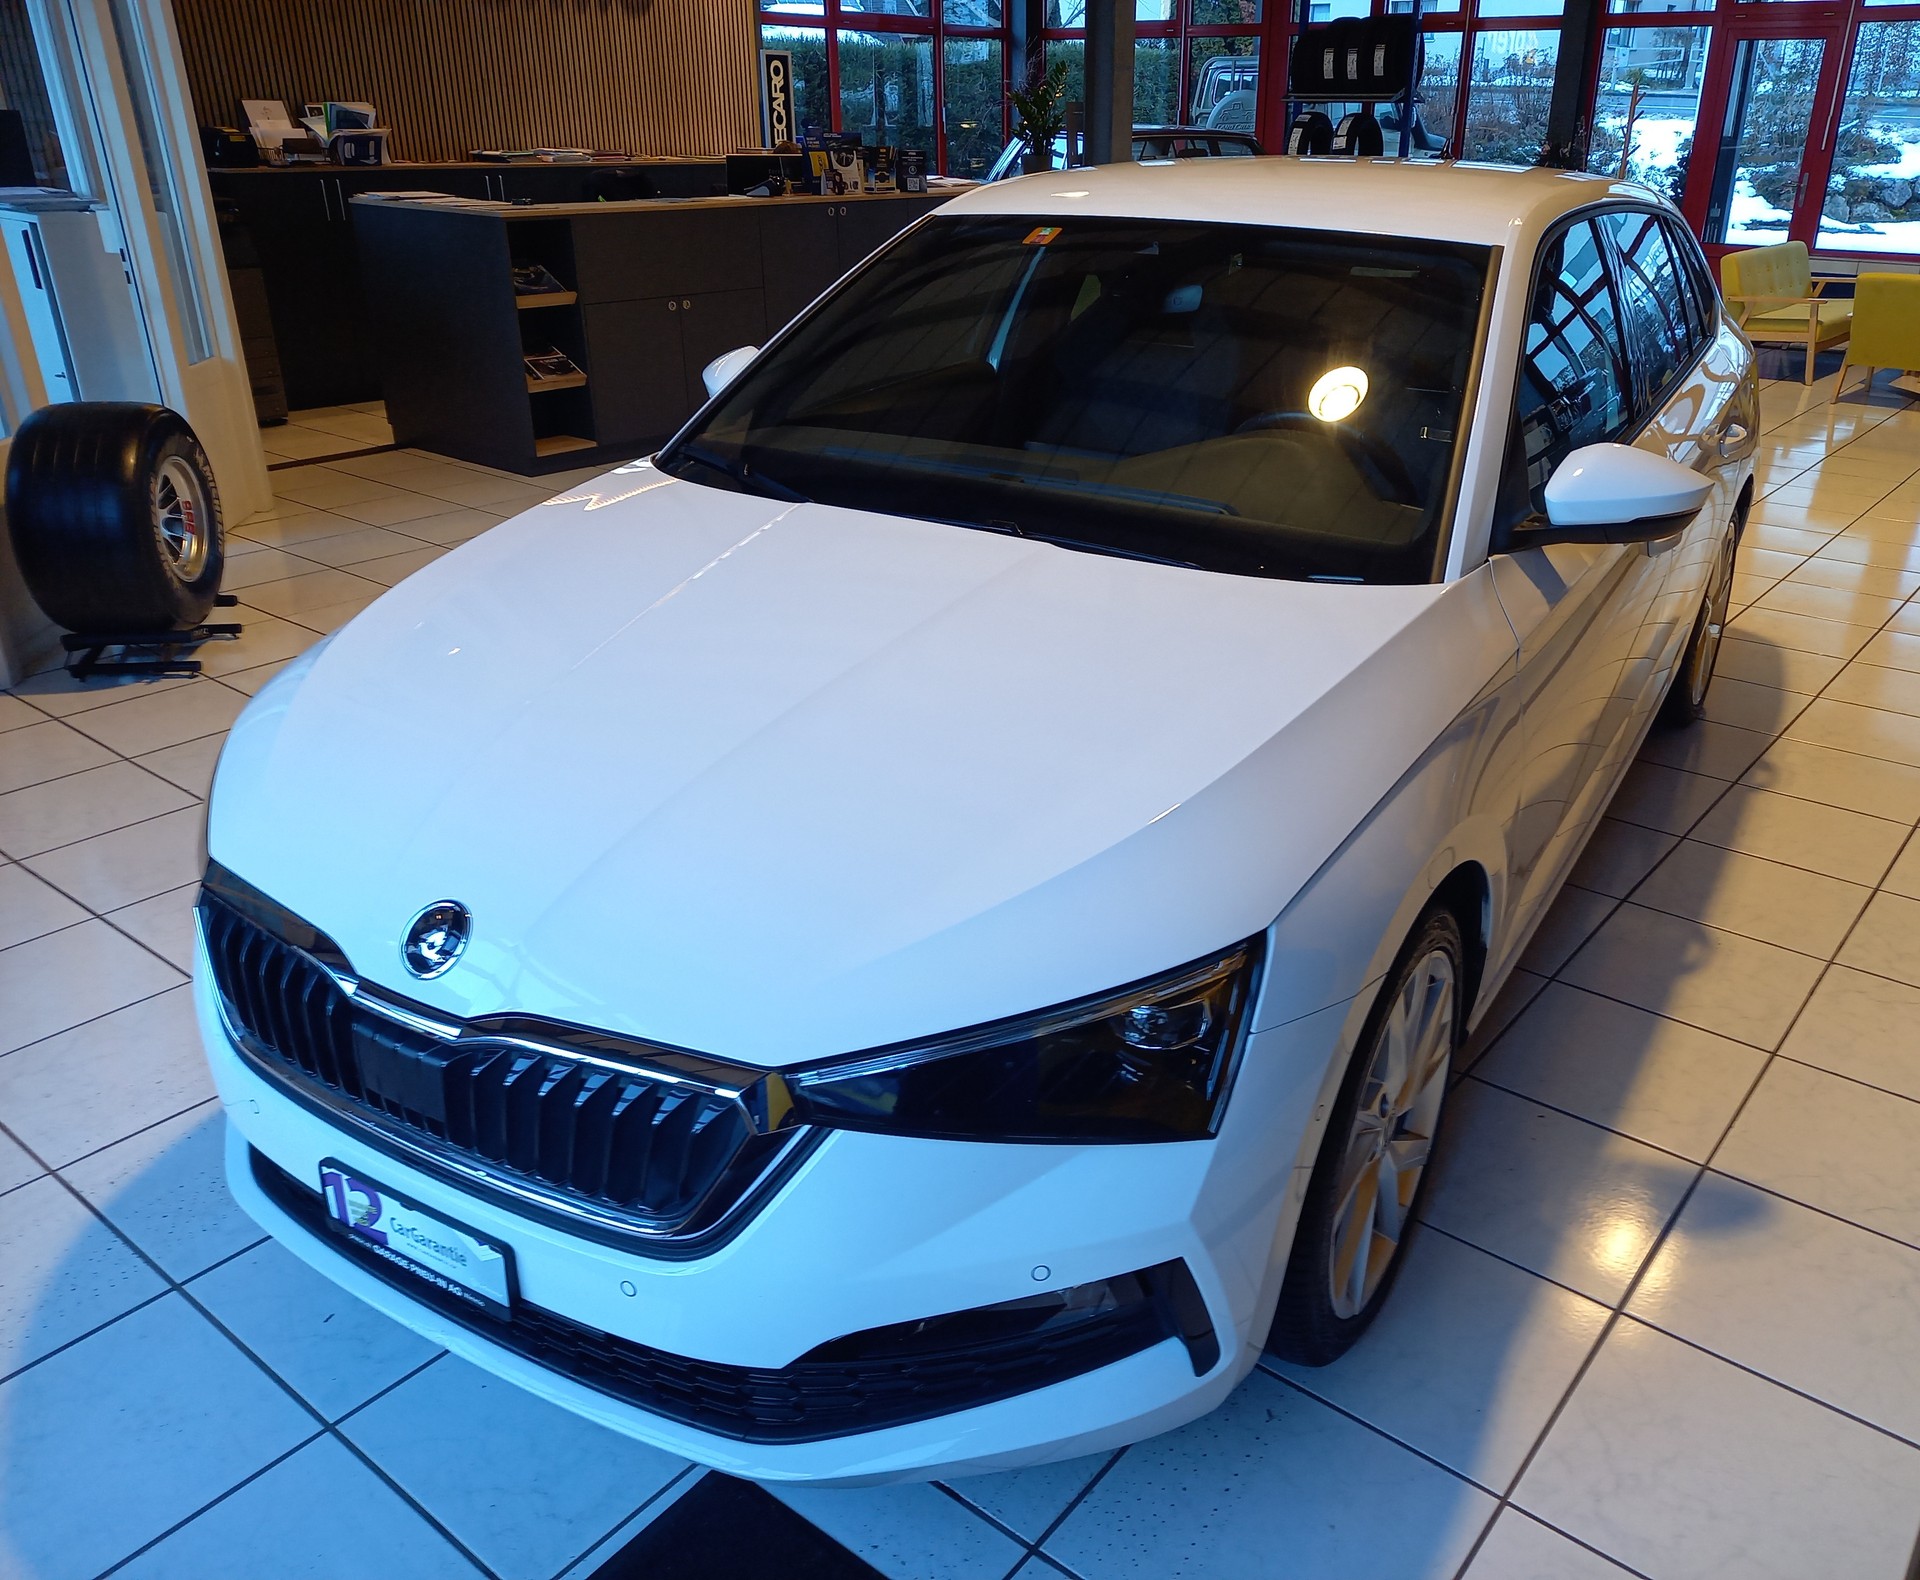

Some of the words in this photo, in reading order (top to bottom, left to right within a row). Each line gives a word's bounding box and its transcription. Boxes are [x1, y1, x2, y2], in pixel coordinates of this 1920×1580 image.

[770, 60, 787, 146] ECARO
[372, 1244, 410, 1270] GARAGE
[390, 1217, 468, 1267] CarGarantie
